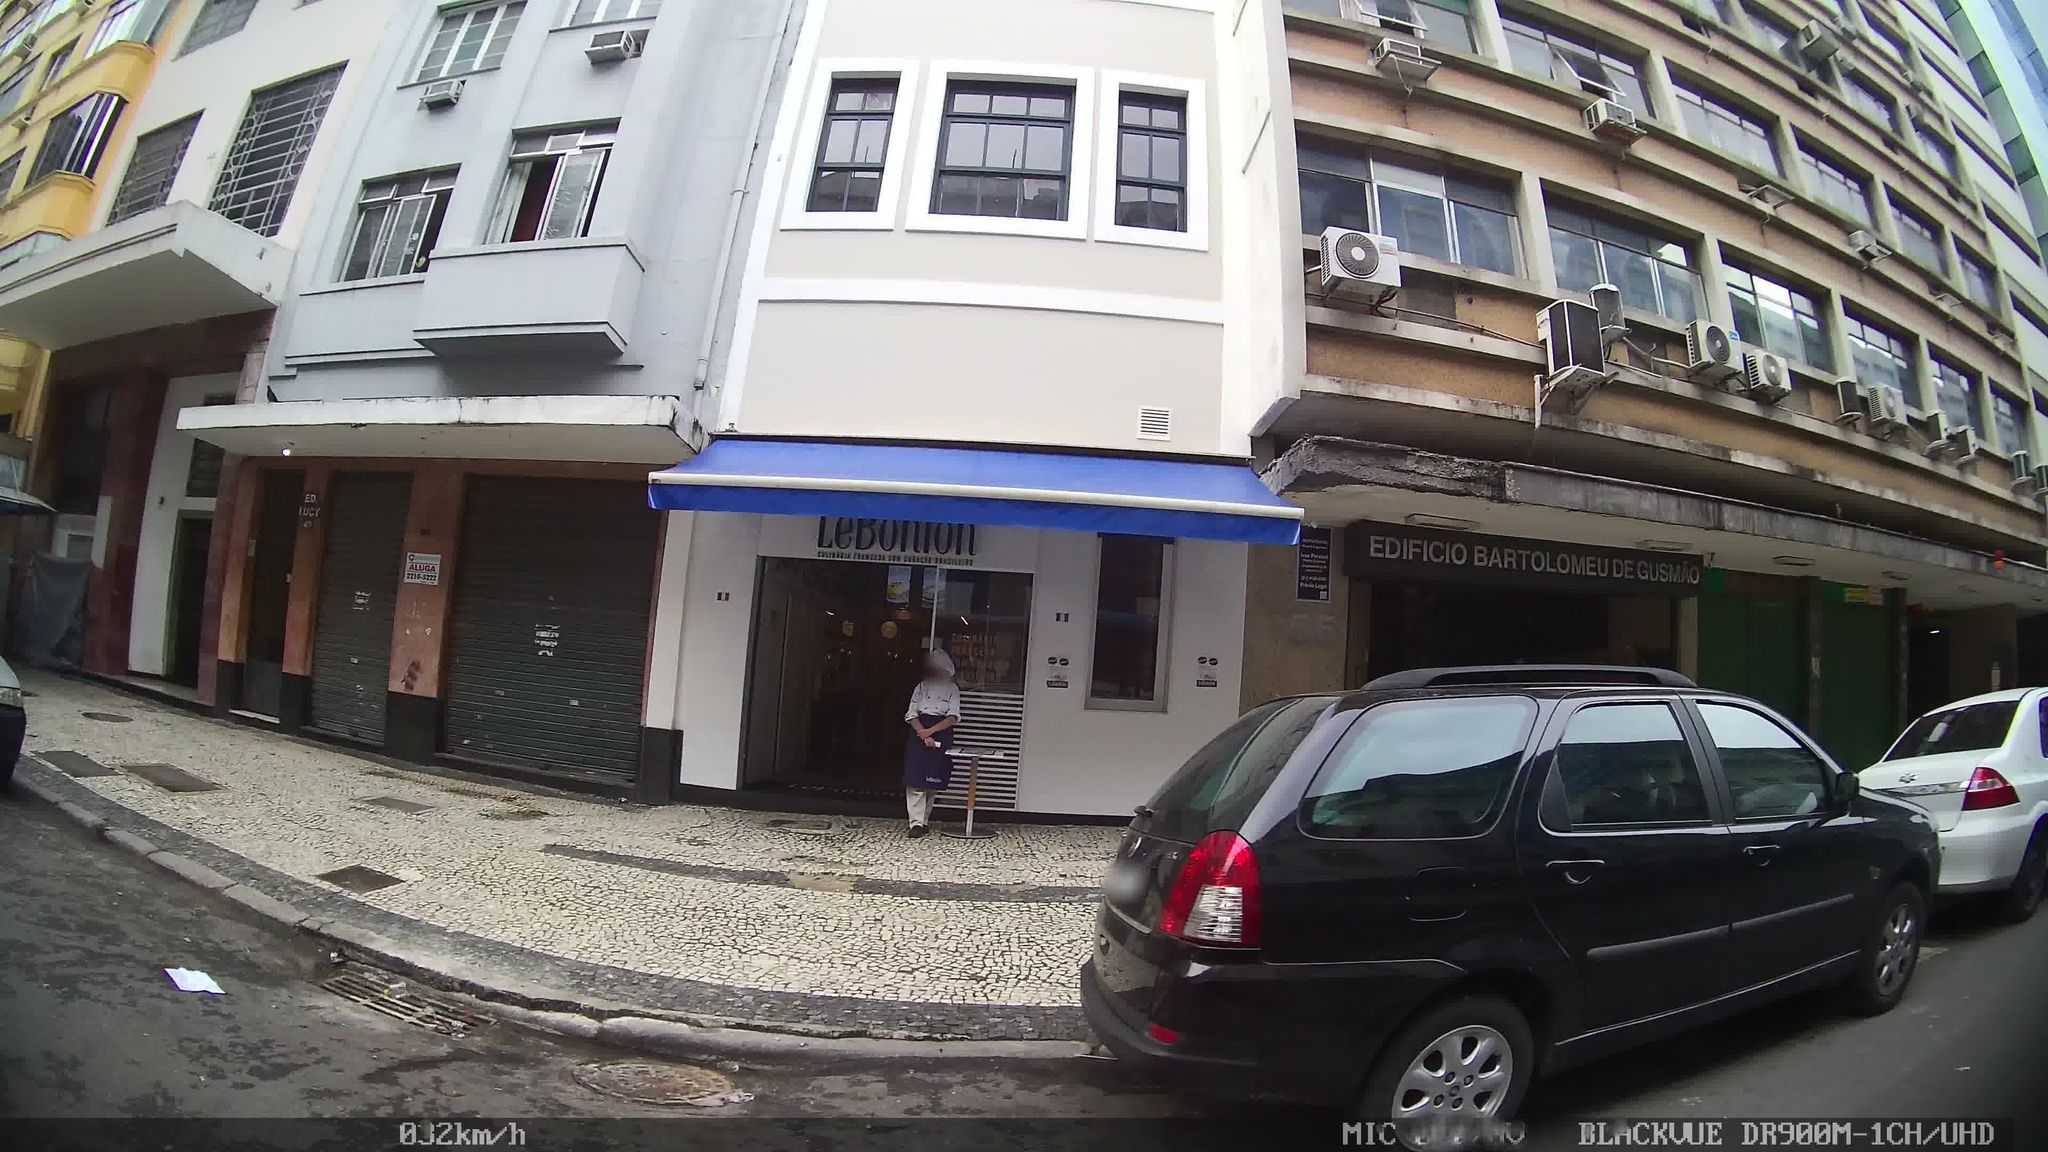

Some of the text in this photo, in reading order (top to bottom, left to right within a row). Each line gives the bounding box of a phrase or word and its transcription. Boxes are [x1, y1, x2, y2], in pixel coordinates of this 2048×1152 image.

[409, 563, 437, 573] ALUGA
[1369, 534, 1701, 585] EDIFICIO BARTOLOMEU DE GUSMÃO
